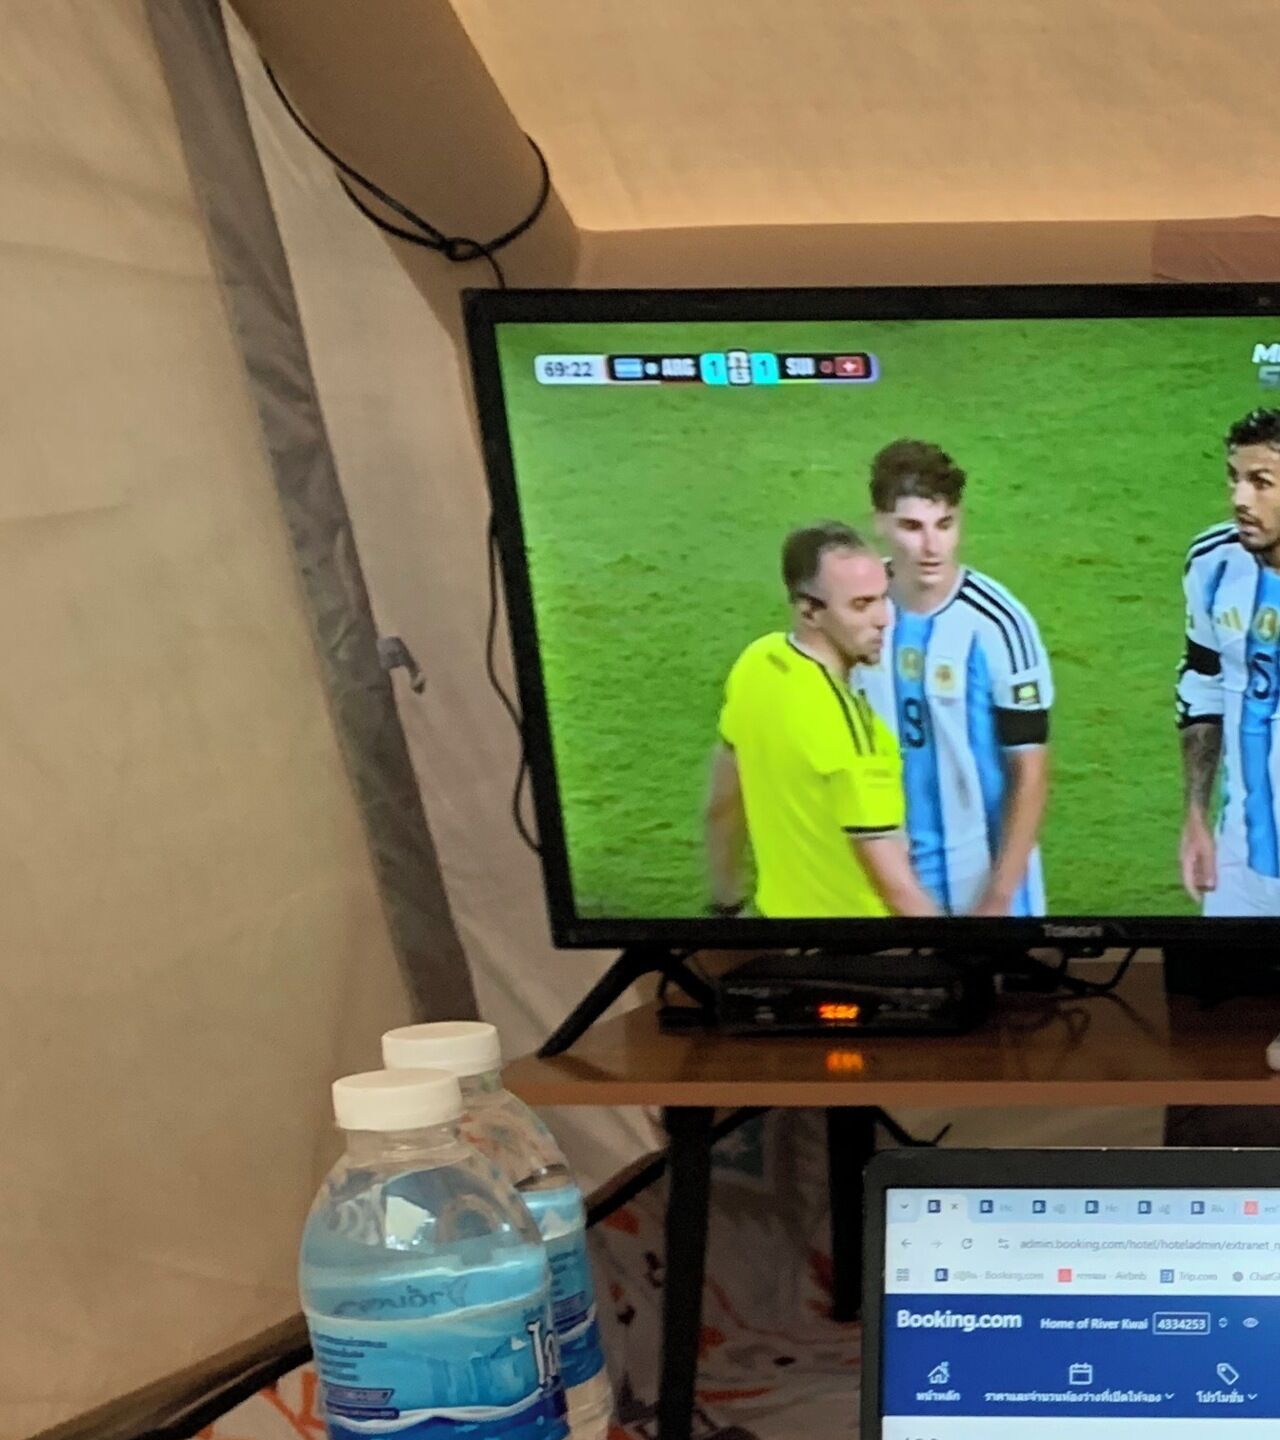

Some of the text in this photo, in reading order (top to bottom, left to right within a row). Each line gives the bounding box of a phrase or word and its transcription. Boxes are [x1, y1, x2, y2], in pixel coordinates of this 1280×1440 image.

[544, 361, 593, 377] 69:22
[710, 360, 718, 376] 1
[760, 360, 768, 376] 1
[904, 697, 925, 748] 9
[984, 1270, 1044, 1282] Booking.com
[1114, 1270, 1147, 1281] Airbnb
[1179, 1272, 1218, 1283] Trip.com
[896, 1310, 1023, 1332] Booking.com
[1040, 1318, 1206, 1331] Home of River Kwai 4334253
[915, 1389, 961, 1402] หน้าหลัก
[1196, 1389, 1244, 1403] โปรโมชั่น
